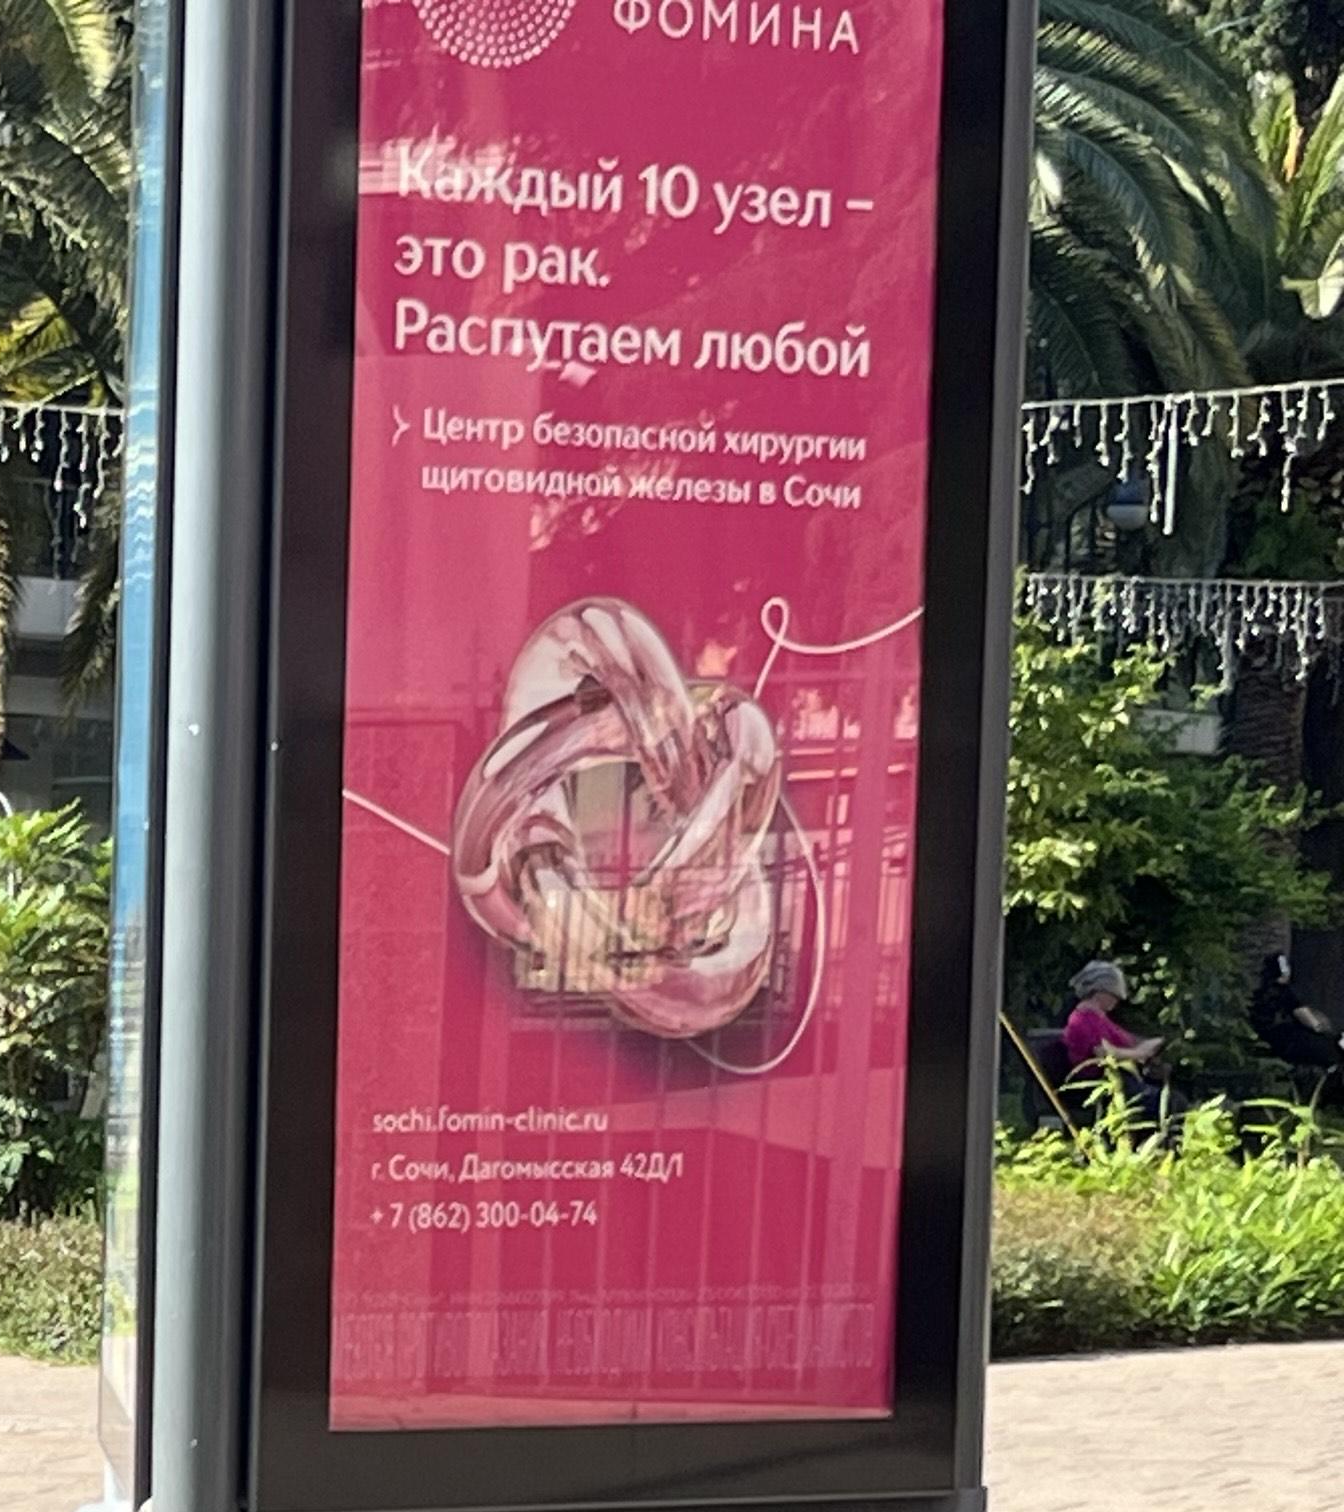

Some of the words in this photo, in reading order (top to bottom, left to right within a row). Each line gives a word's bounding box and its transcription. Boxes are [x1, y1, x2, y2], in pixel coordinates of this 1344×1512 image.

[613, 0, 860, 55] ФОМИНА
[398, 146, 621, 216] Каждый
[638, 164, 699, 218] 10
[713, 181, 831, 234] узел
[394, 234, 486, 280] это
[503, 242, 610, 294] рак.
[394, 298, 681, 373] Распутаем
[694, 320, 872, 377] любой
[423, 407, 523, 450] Центр
[533, 411, 716, 453] безопасной
[723, 430, 866, 466] хирургии
[422, 464, 624, 497] щитовидной
[628, 474, 750, 502] железы
[759, 481, 775, 505] в
[784, 474, 861, 508] Сочи
[373, 1105, 608, 1132] sochi.fomin-clinic.ru
[388, 1153, 456, 1183] Сочи,
[458, 1153, 614, 1183] Дагомысская
[409, 1202, 470, 1233] (862)
[476, 1200, 597, 1228] 300-04-74
